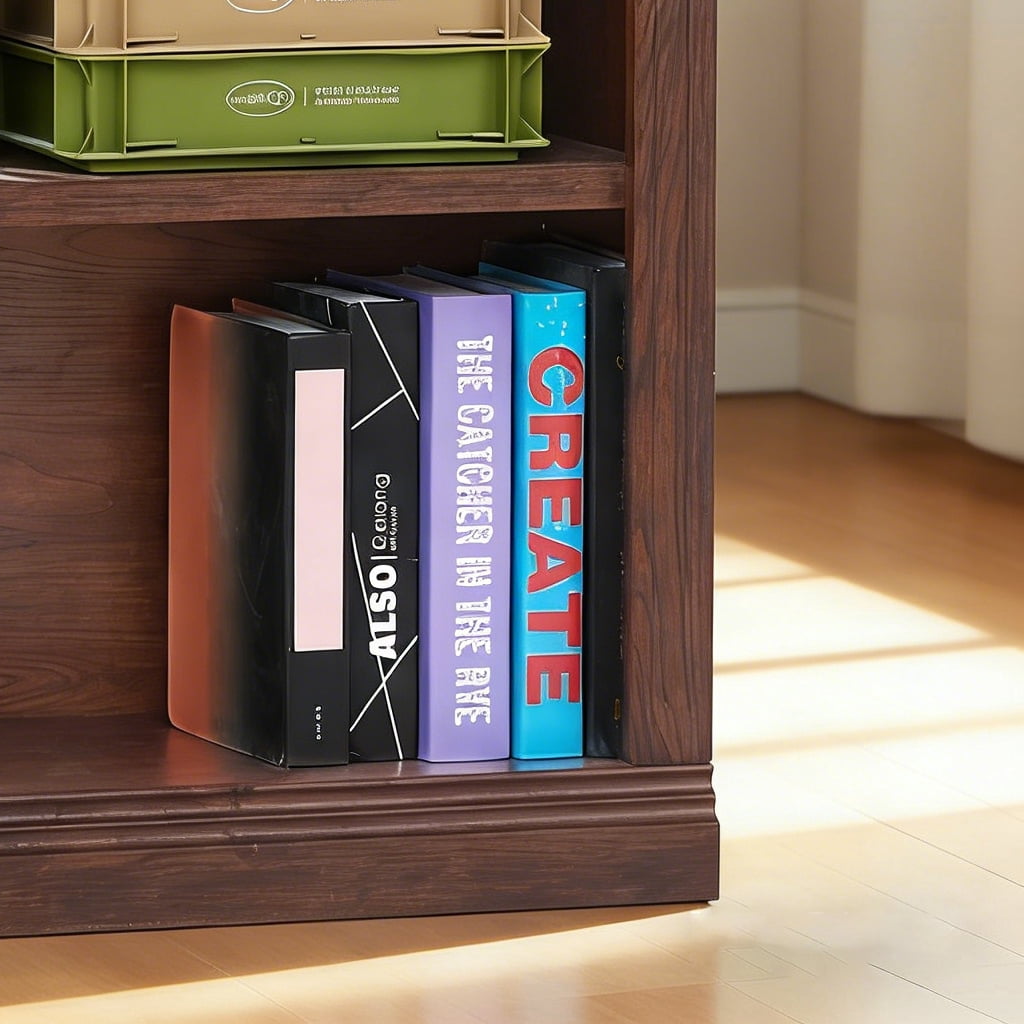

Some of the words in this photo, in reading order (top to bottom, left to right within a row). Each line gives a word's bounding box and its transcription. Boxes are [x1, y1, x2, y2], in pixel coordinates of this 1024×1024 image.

[456, 335, 494, 394] THE
[455, 404, 494, 545] CATCHER
[527, 347, 584, 704] CREATE
[455, 556, 493, 587] IN
[368, 564, 398, 660] ALSO
[455, 596, 493, 657] THE
[454, 667, 493, 726] RYE
